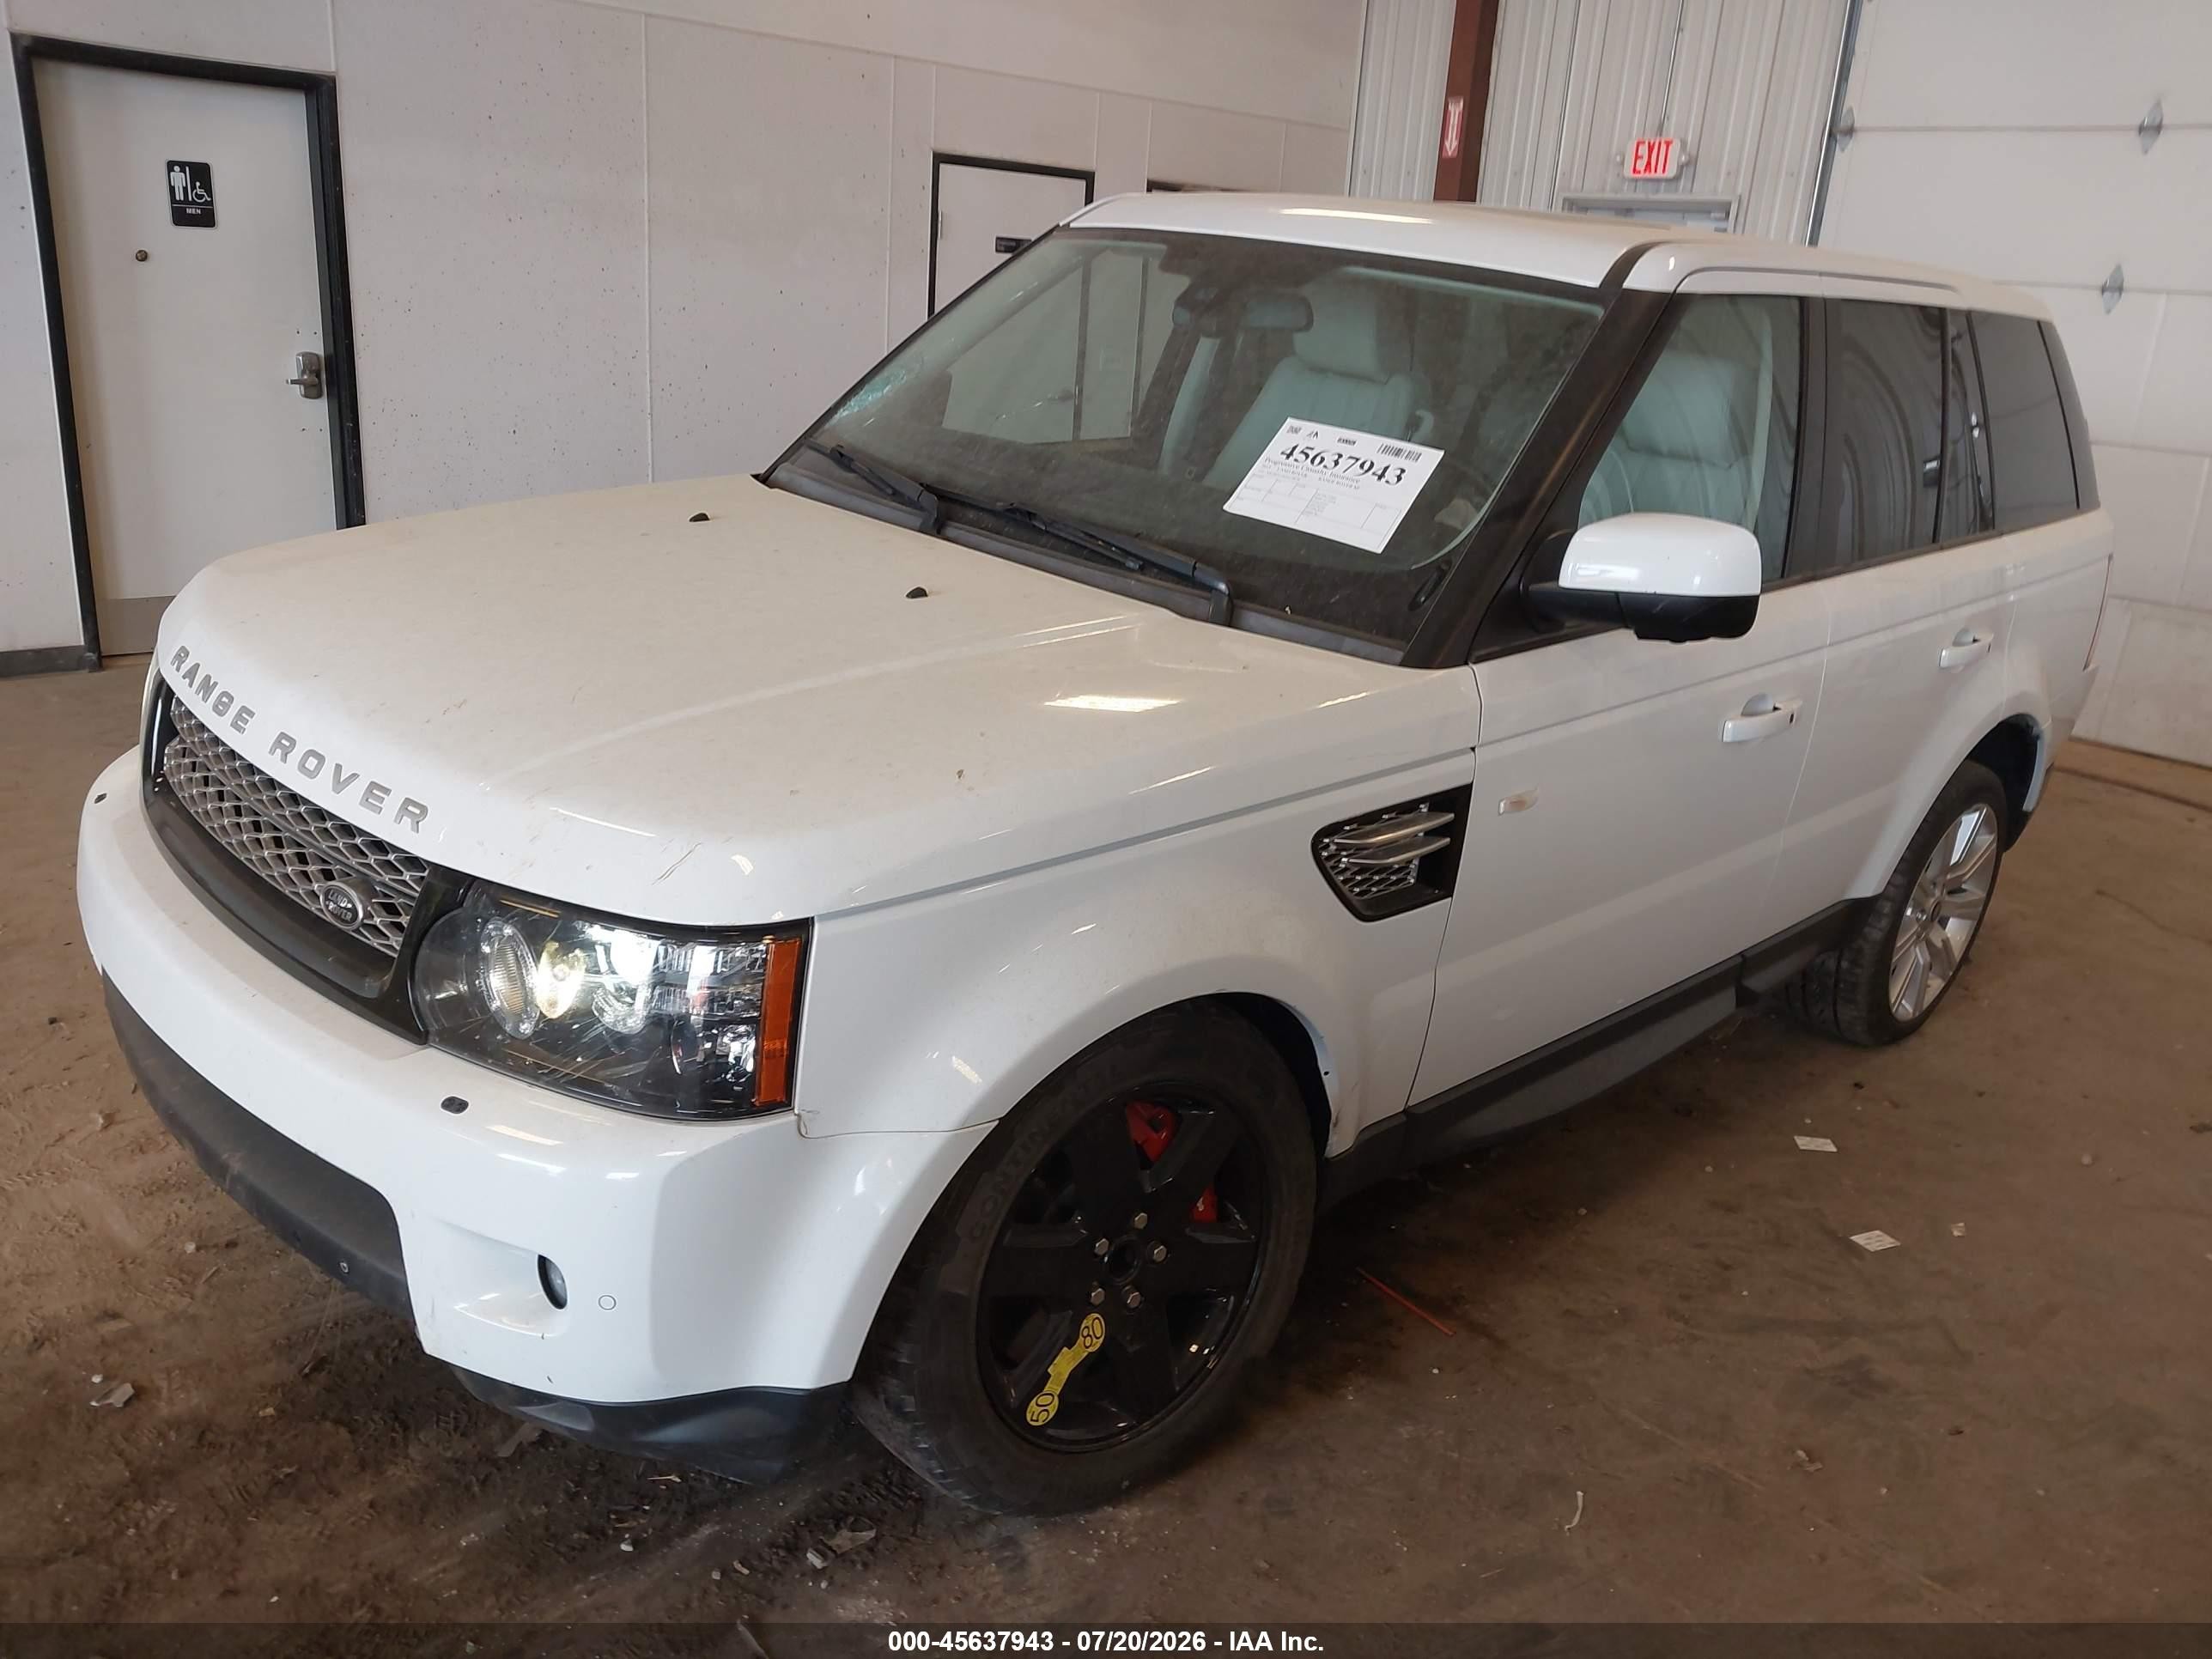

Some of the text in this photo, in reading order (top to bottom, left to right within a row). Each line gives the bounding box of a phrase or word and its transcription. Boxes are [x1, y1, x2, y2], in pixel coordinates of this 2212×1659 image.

[1632, 139, 1674, 174] EXIT
[1280, 443, 1407, 486] 45637943
[170, 646, 428, 834] RANGE ROVER
[1081, 1316, 1103, 1349] 80
[1030, 1392, 1055, 1423] 50
